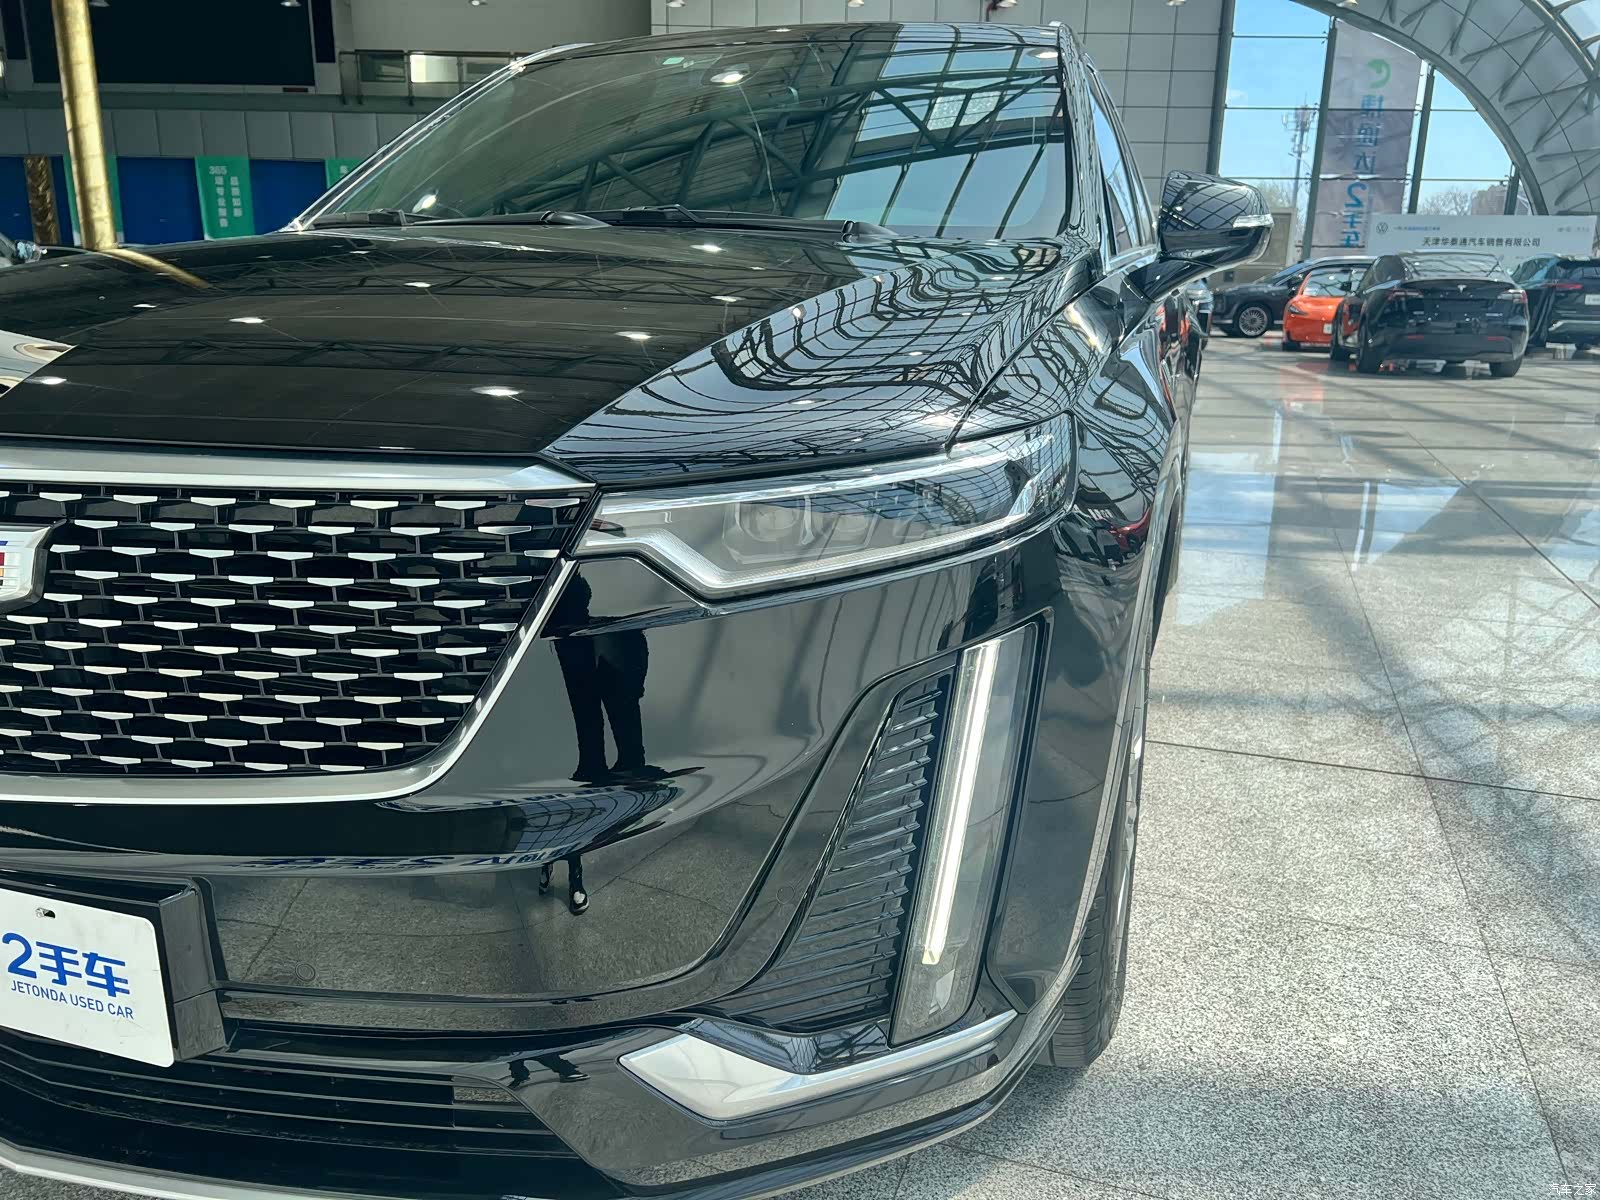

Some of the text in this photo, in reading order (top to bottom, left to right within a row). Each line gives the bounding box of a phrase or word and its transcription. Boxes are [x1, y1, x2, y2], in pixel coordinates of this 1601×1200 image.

[2, 932, 130, 998] 2手车
[11, 980, 134, 1019] JETONDA USED CAR
